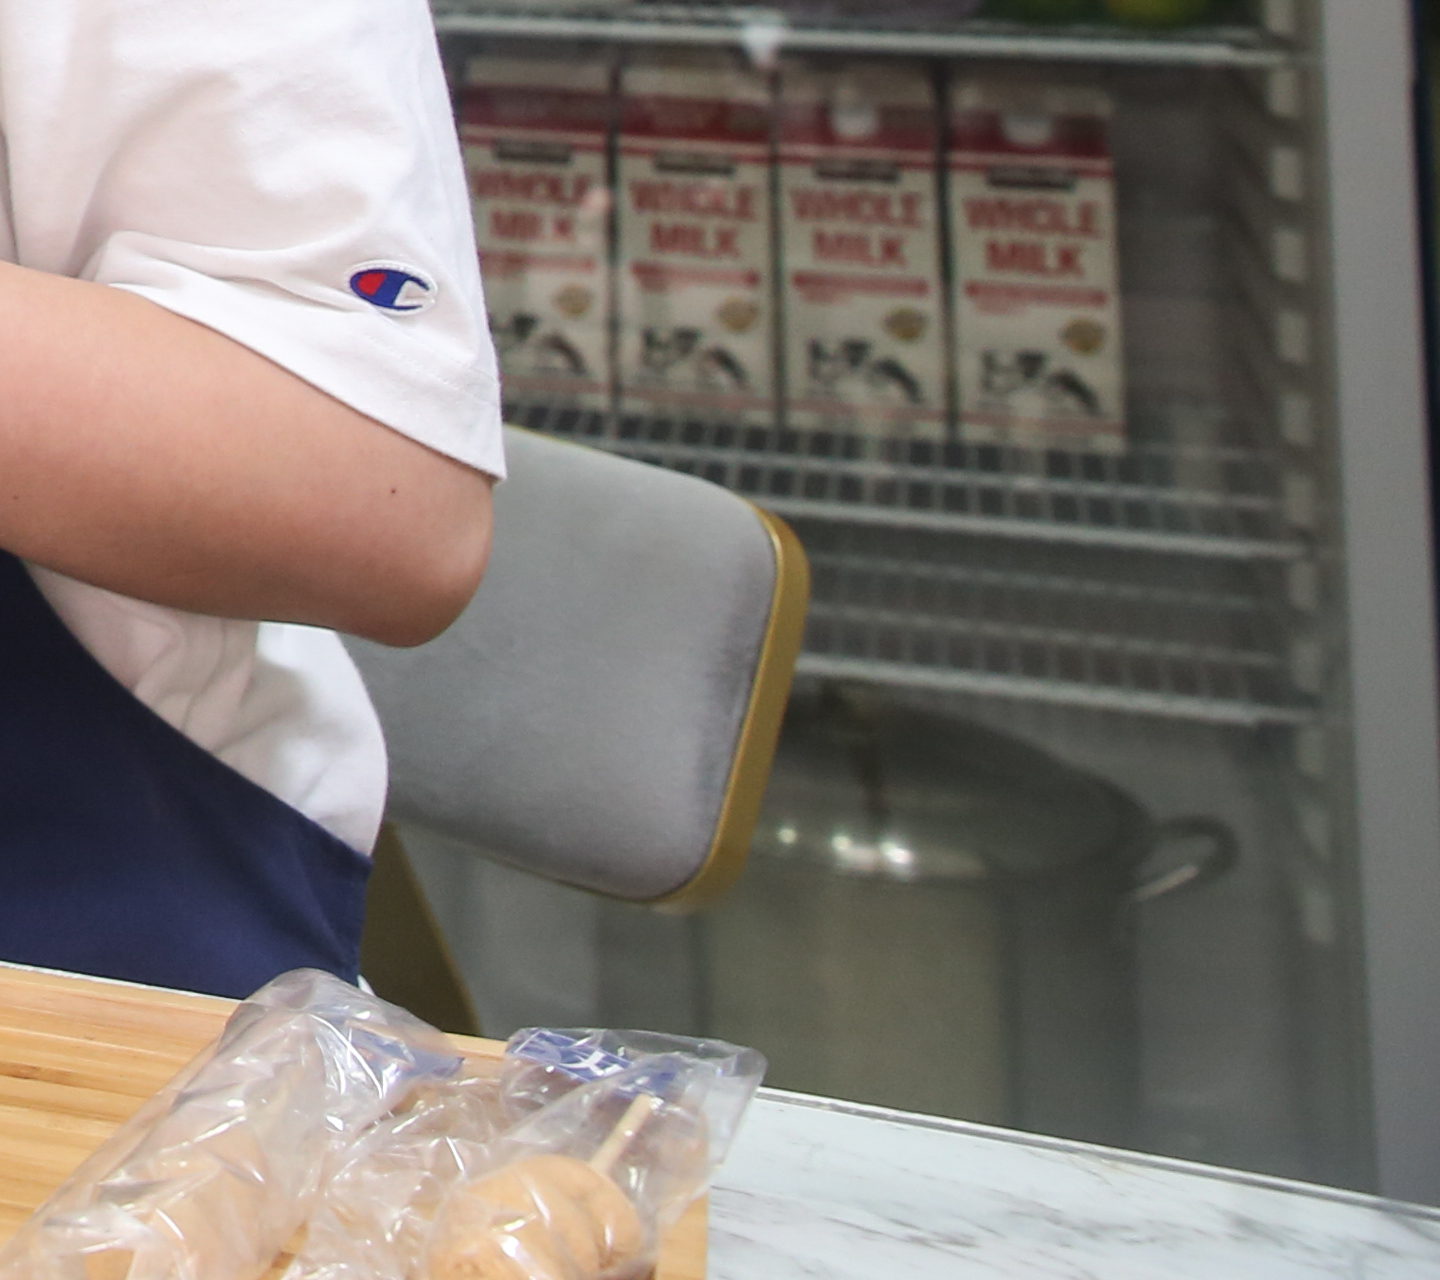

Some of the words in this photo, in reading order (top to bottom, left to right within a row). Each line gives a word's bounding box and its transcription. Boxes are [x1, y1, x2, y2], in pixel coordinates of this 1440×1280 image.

[629, 178, 759, 221] WHOLE
[791, 186, 924, 228] WHOLE
[961, 197, 1100, 239] WHOLE
[649, 221, 742, 259] MILK
[811, 231, 909, 269] MILK
[986, 241, 1086, 279] MILK
